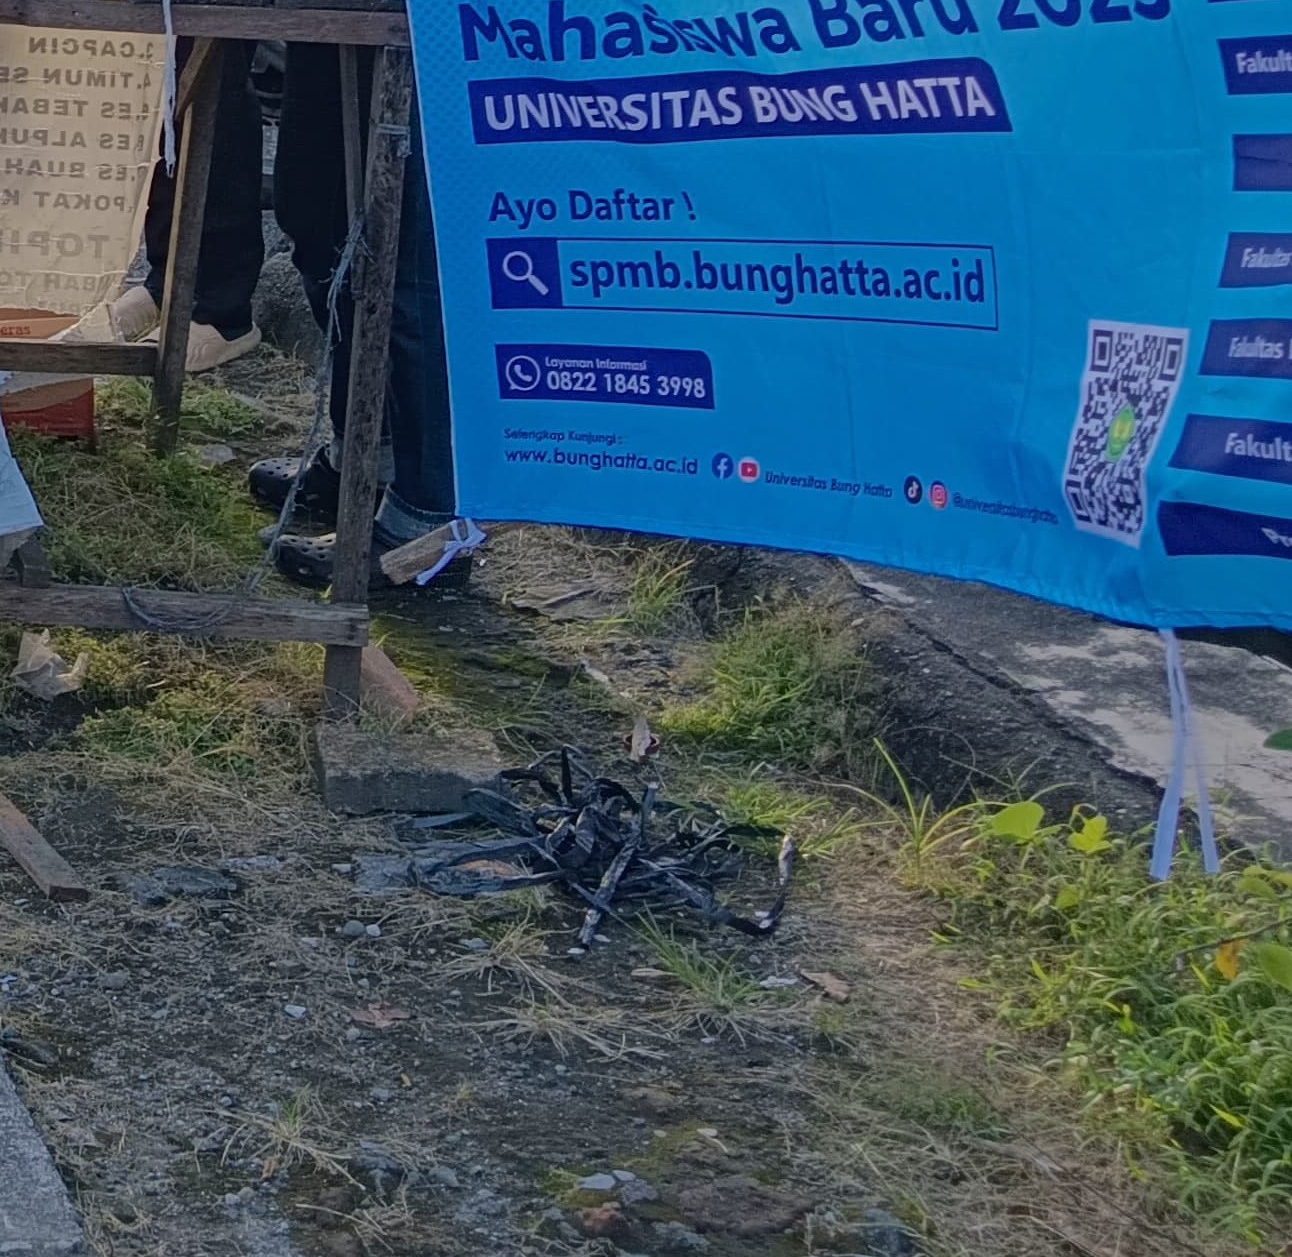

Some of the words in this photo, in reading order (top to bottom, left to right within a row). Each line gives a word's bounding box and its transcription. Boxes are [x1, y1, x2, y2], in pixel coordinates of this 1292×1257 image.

[483, 85, 744, 132] UNIVERSITAS
[747, 83, 859, 125] BUNG
[859, 75, 996, 122] HATTA
[488, 192, 558, 230] Ayo
[568, 187, 676, 222] Daftar
[569, 250, 985, 305] spmb.bunghatta.ac.id
[544, 356, 595, 370] Layanan
[596, 359, 648, 372] Informasi
[547, 371, 598, 393] 0822
[603, 373, 651, 395] 1845
[656, 376, 706, 399] 3998
[504, 427, 565, 444] Selengkap
[505, 448, 699, 475] www.bunghatta.ac.id
[765, 470, 828, 491] Universitas
[830, 477, 861, 497] Bung
[863, 482, 894, 499] Hatta
